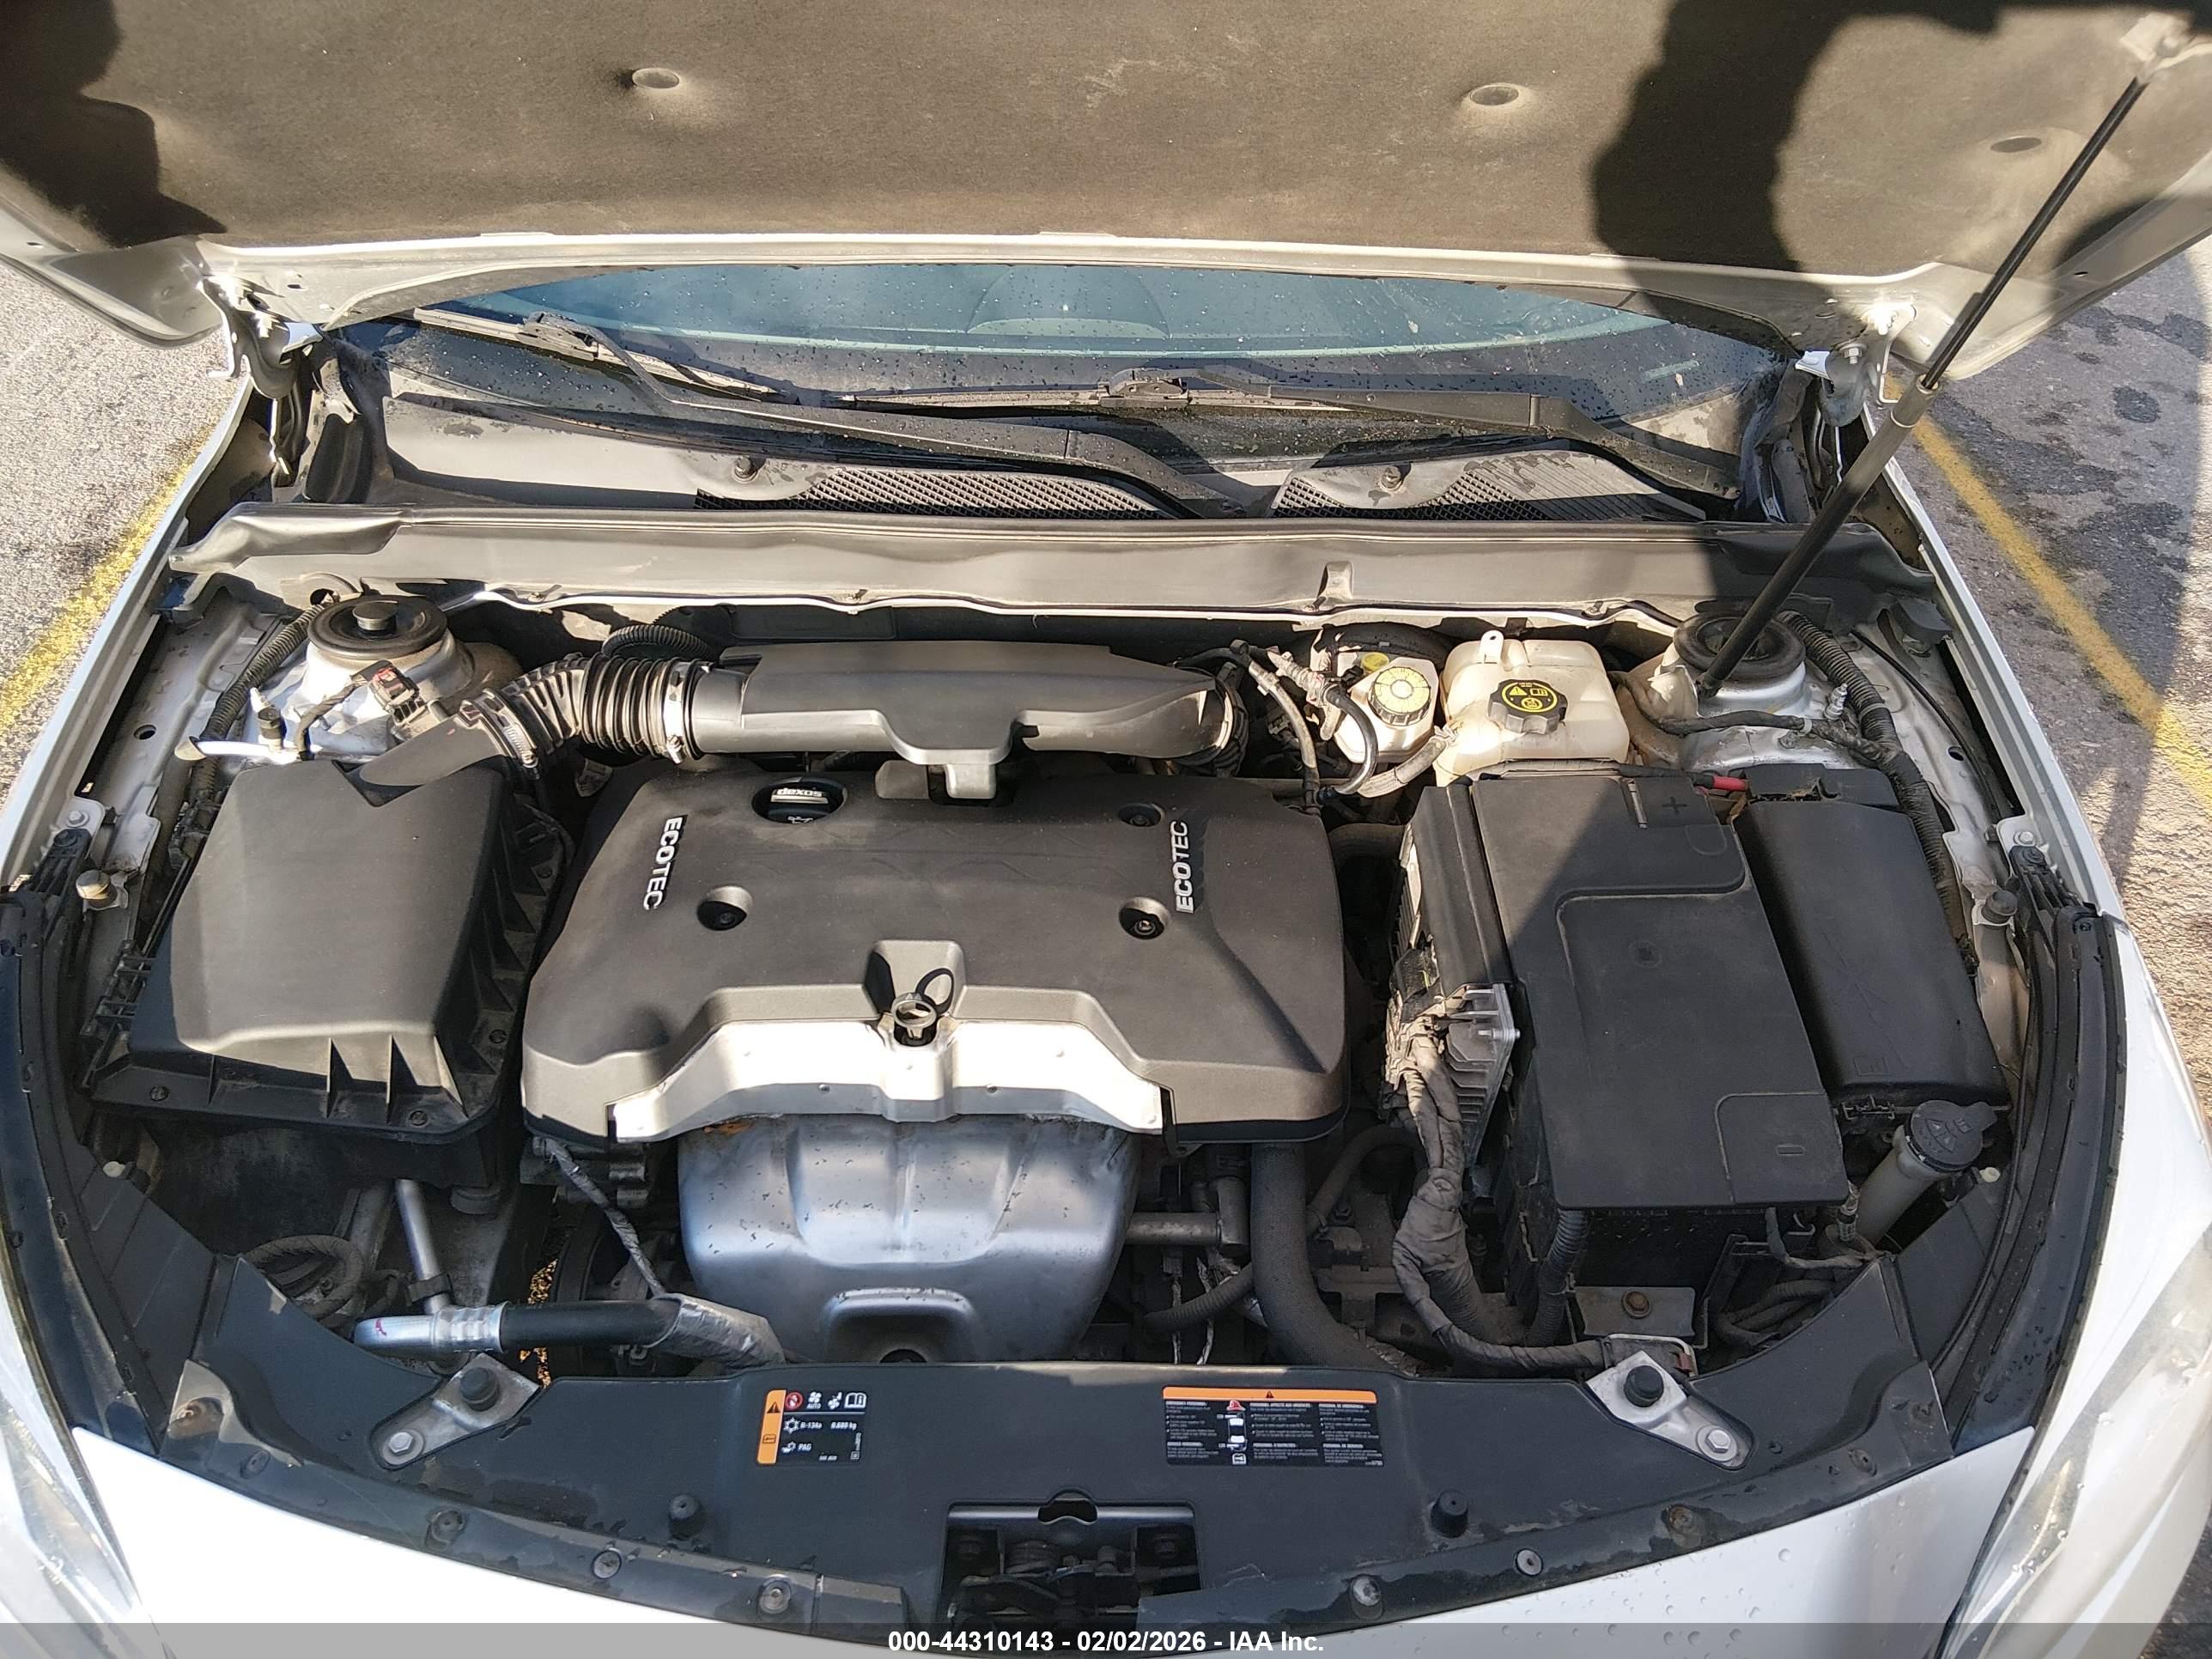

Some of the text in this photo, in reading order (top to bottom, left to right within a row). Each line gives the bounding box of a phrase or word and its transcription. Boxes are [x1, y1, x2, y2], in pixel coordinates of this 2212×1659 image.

[776, 787, 823, 798] dexos
[643, 817, 684, 910] ECOTEC
[1170, 820, 1194, 914] ECOTEC
[797, 1443, 812, 1452] PAG
